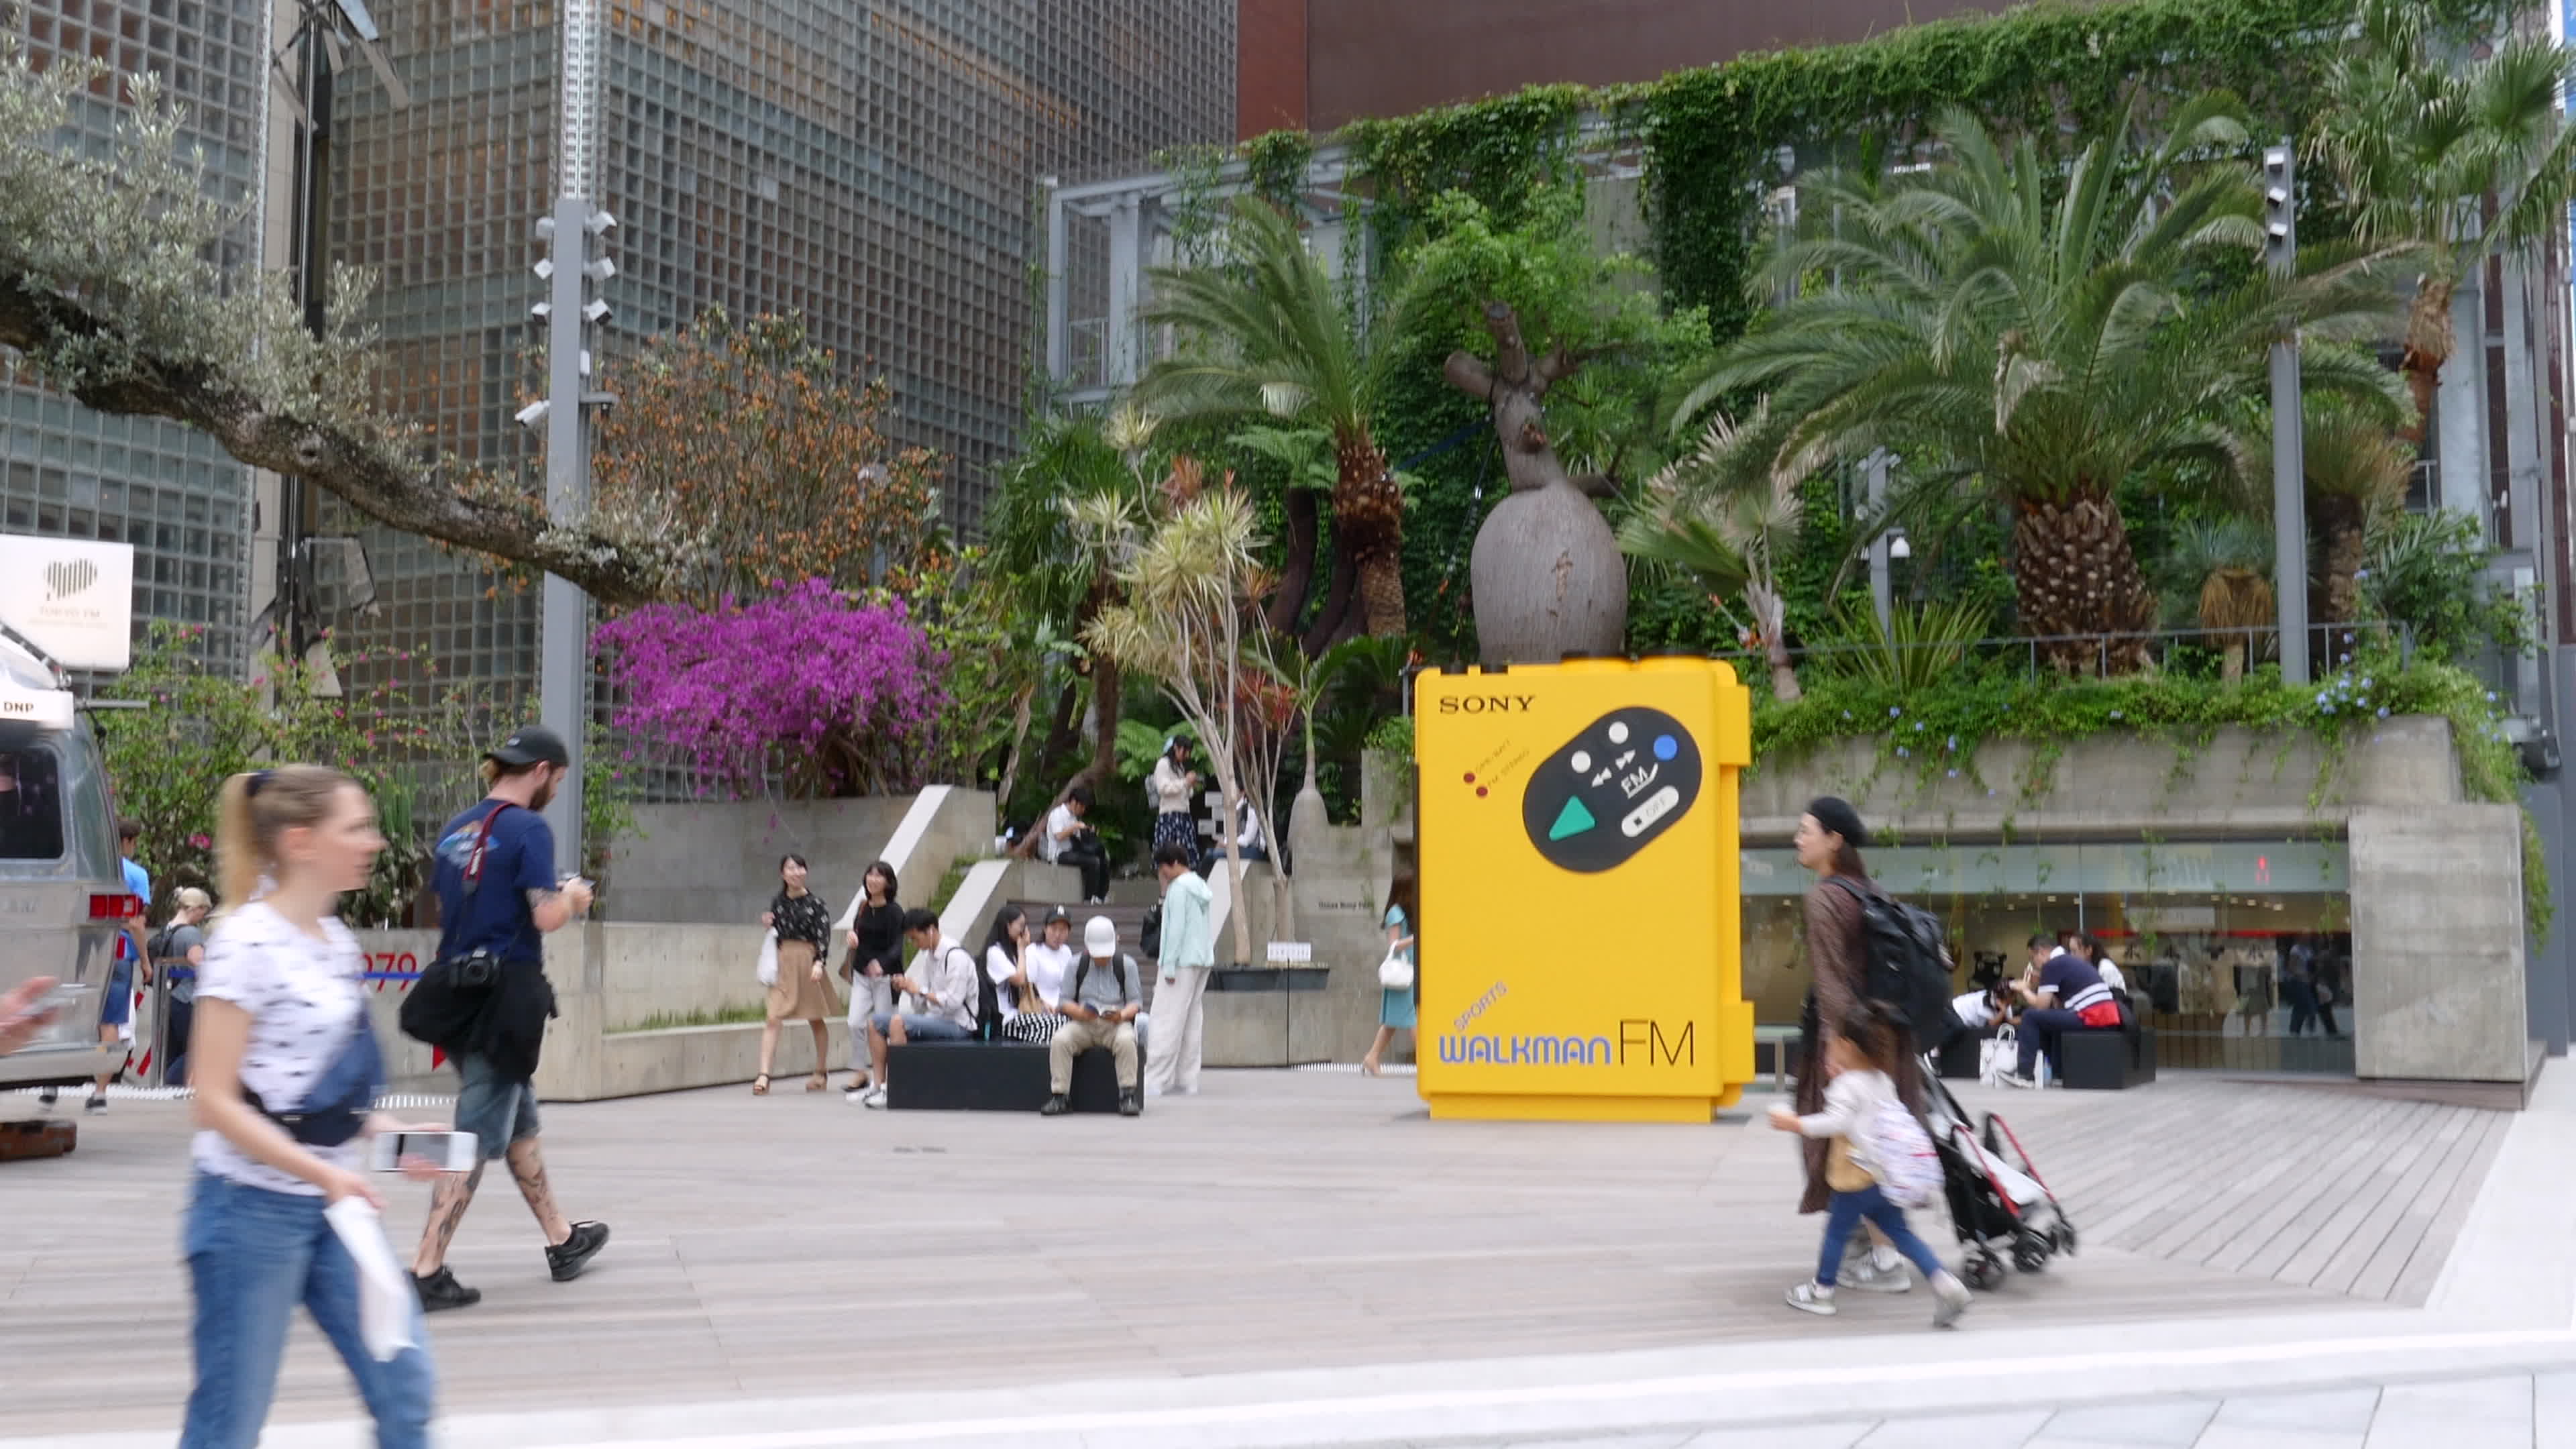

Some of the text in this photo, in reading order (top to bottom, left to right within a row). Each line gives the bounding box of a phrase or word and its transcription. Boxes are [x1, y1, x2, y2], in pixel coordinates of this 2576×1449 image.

[3, 701, 34, 712] DNP
[1440, 695, 1536, 714] SONY
[1621, 765, 1650, 798] FM
[1454, 980, 1507, 1032] SPORTS
[1439, 1019, 1694, 1067] WALKMAN FM
